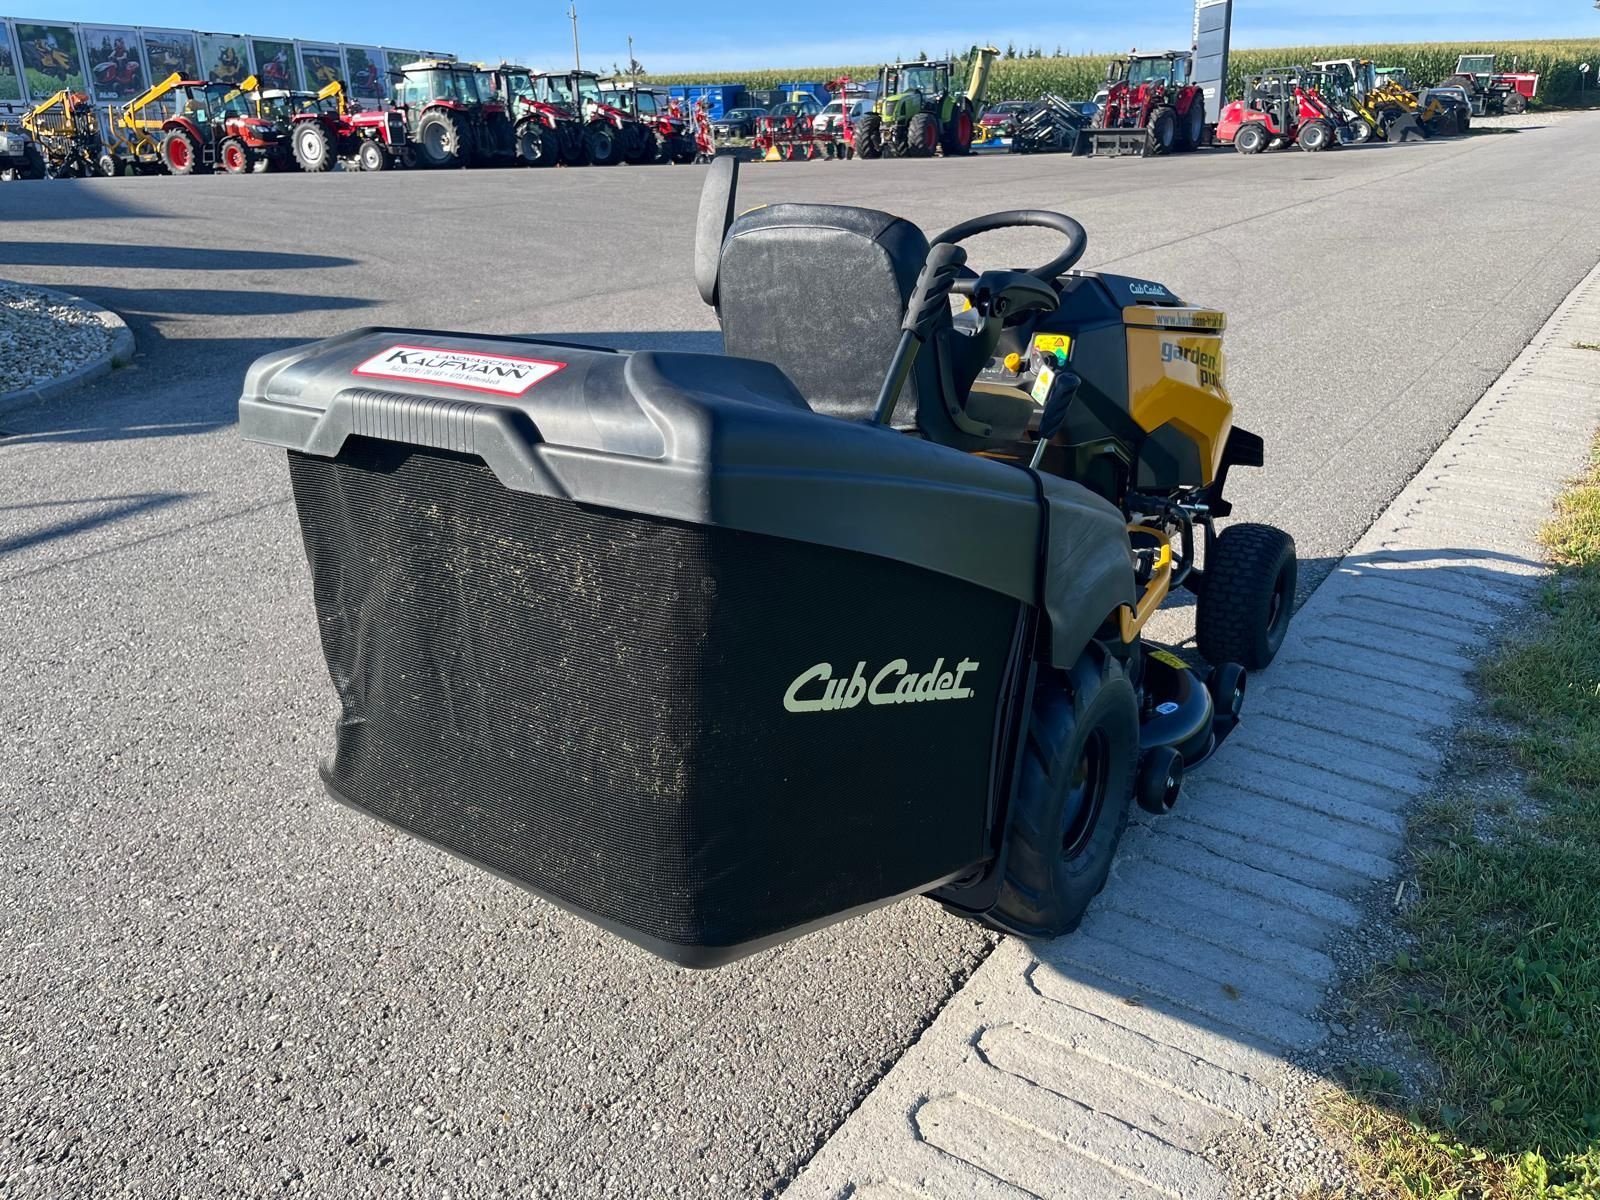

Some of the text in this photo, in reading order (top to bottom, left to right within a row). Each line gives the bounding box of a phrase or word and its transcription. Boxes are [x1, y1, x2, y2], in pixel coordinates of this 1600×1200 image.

[385, 351, 529, 379] KAUFMANN
[1161, 342, 1216, 371] garden
[783, 657, 979, 712] Cub Cadet
